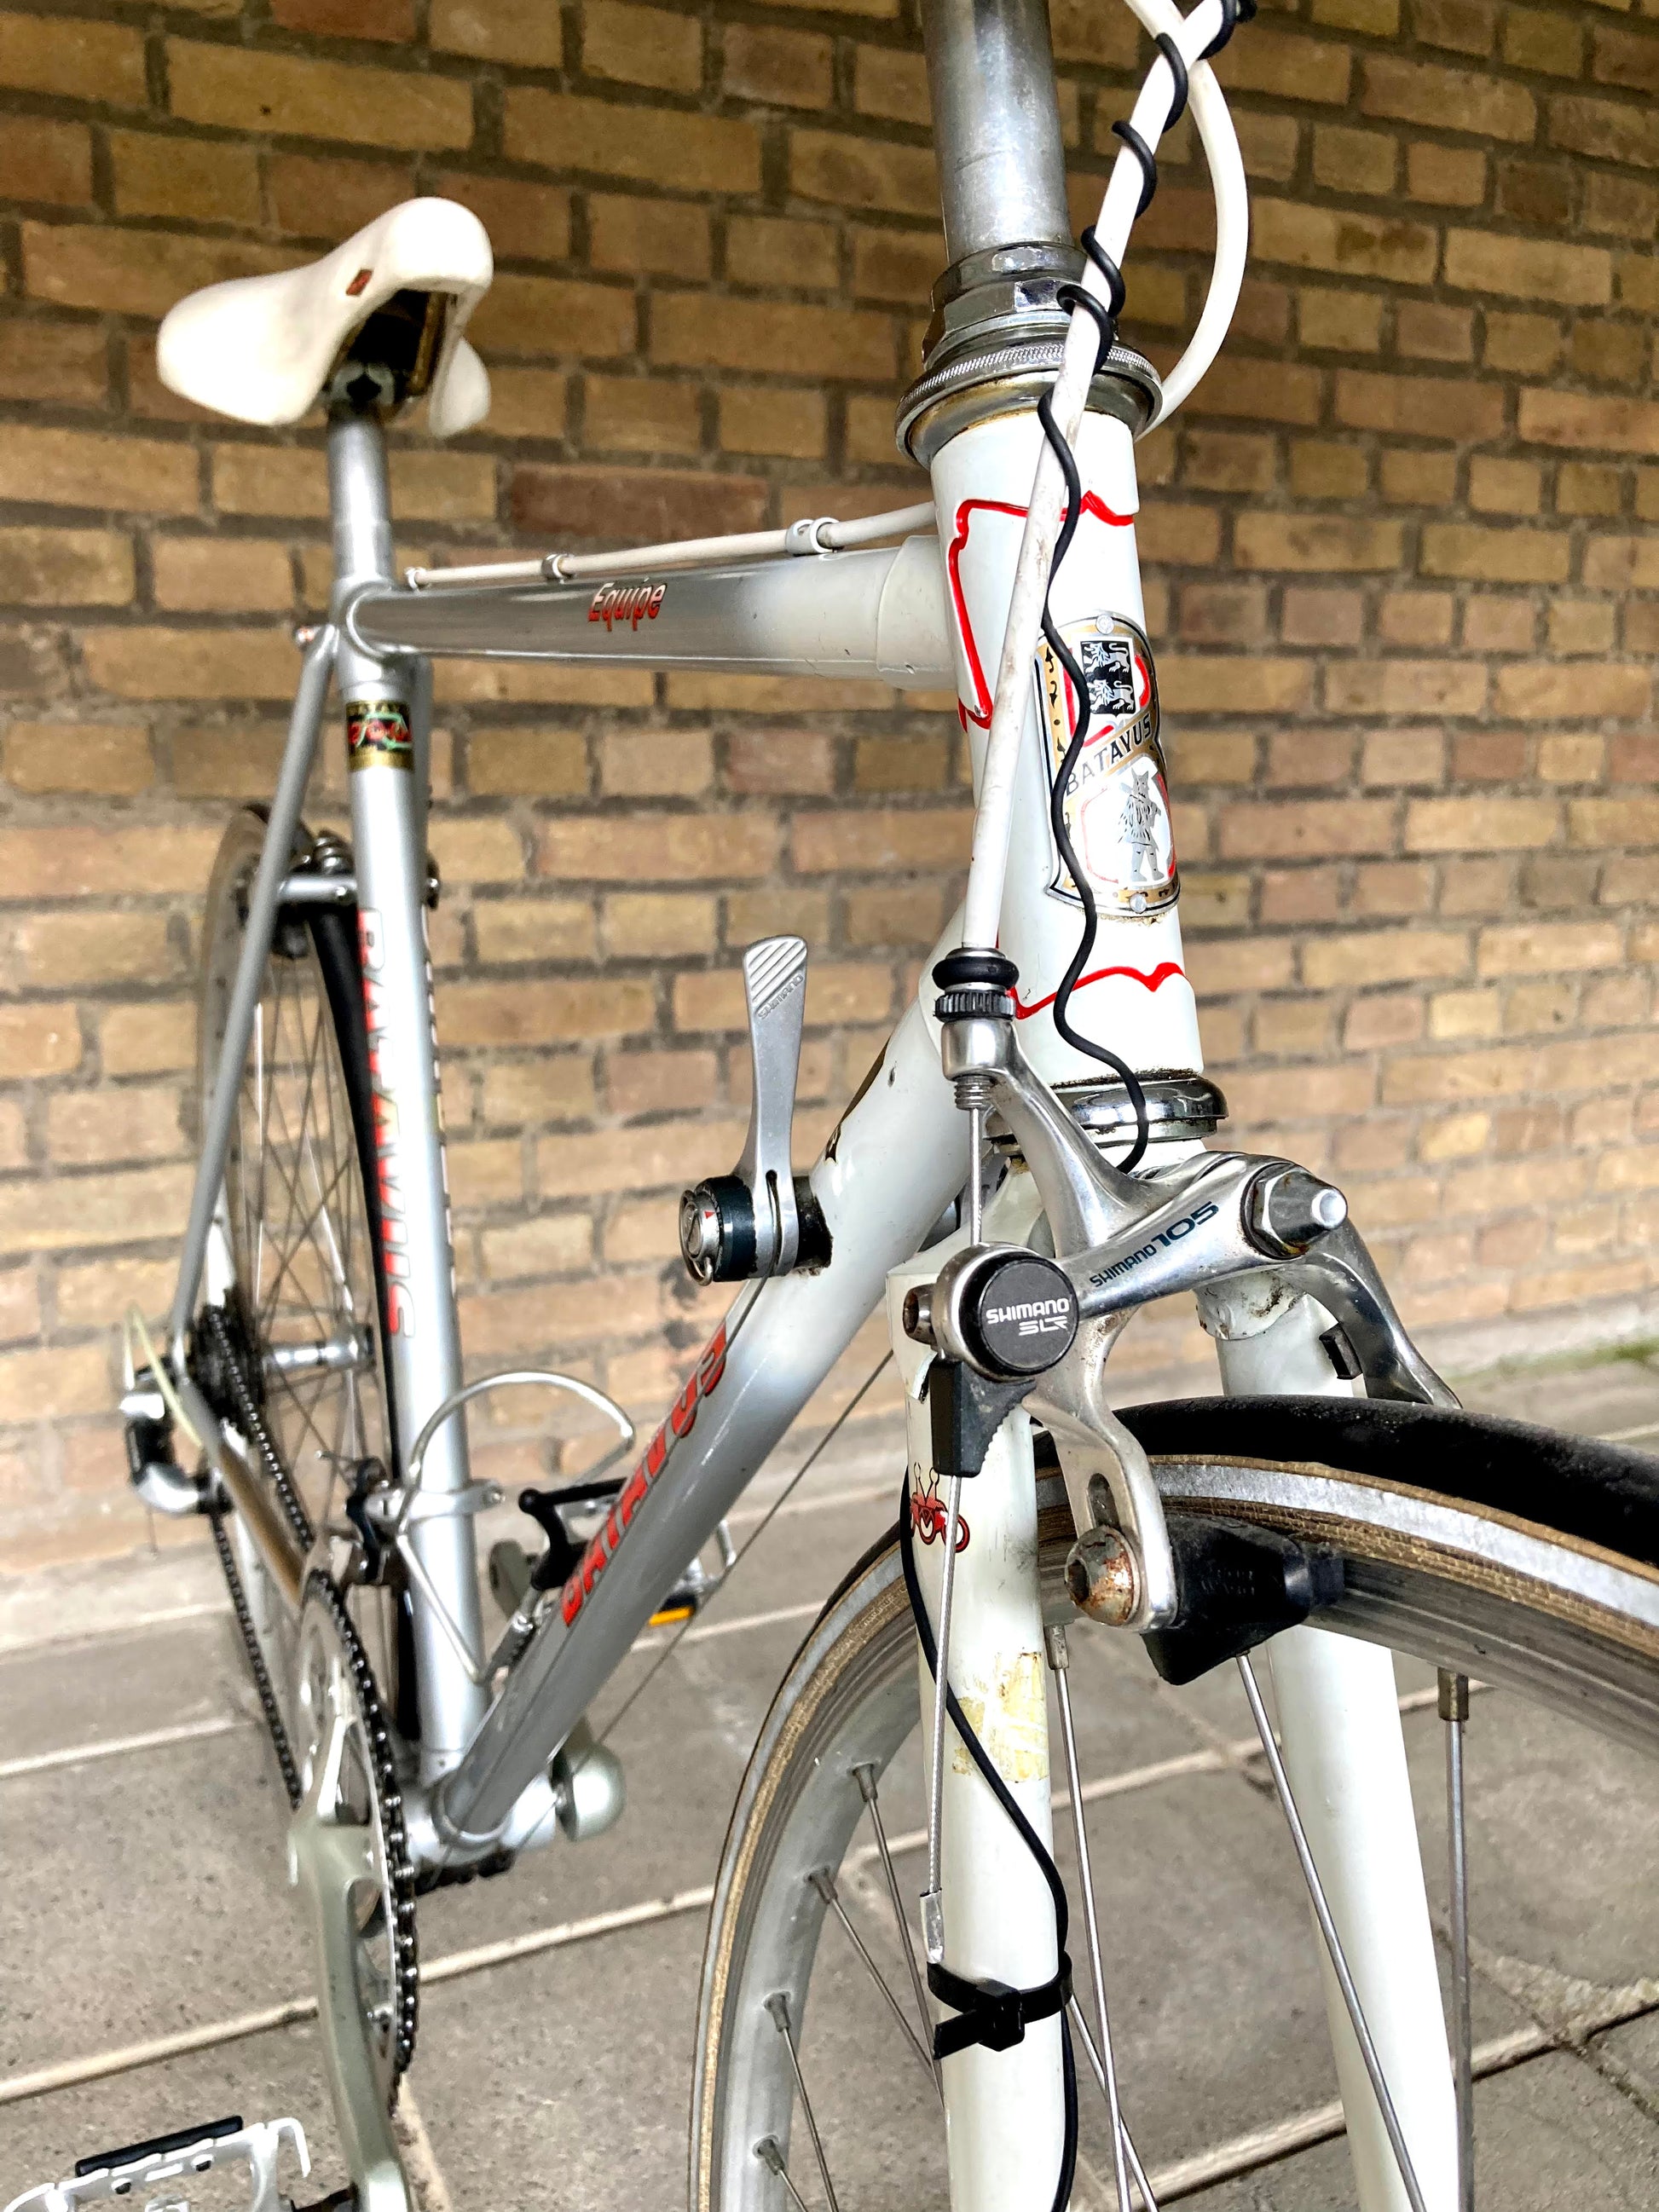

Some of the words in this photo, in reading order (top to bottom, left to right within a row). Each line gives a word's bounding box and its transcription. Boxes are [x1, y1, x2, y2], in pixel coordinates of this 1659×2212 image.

[588, 576, 668, 632] Equipe
[1066, 712, 1152, 797] BATAVUS
[1089, 1244, 1157, 1288] SHIMANO
[1151, 1200, 1220, 1247] 105
[986, 1297, 1070, 1325] SHIMANO
[1018, 1315, 1068, 1337] SLR
